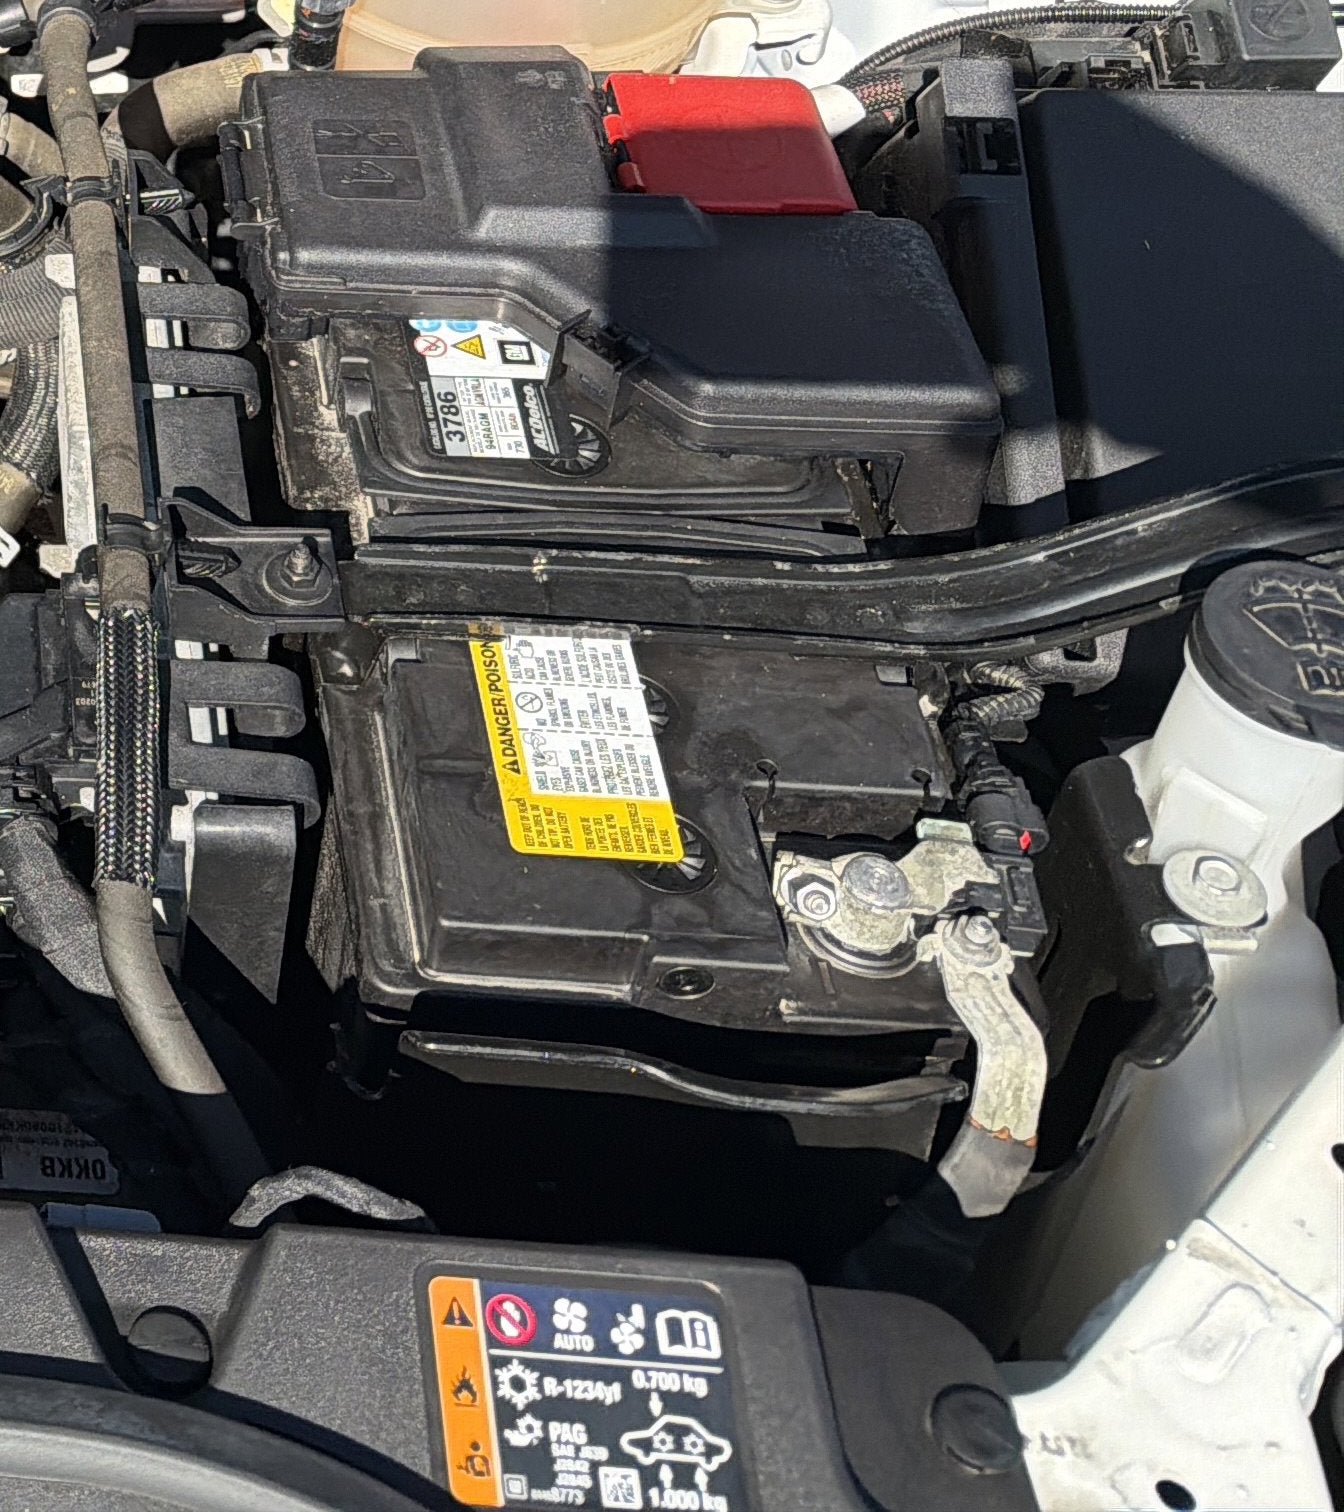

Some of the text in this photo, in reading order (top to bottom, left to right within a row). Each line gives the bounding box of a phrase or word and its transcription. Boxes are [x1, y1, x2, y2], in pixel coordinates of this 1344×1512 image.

[437, 391, 466, 443] 3786
[554, 1332, 595, 1353] AUTO
[543, 1376, 623, 1406] R-1234yf
[632, 1369, 708, 1399] 0.700 kg
[549, 1421, 588, 1445] PAG
[649, 1487, 728, 1512] 1.000 kg
